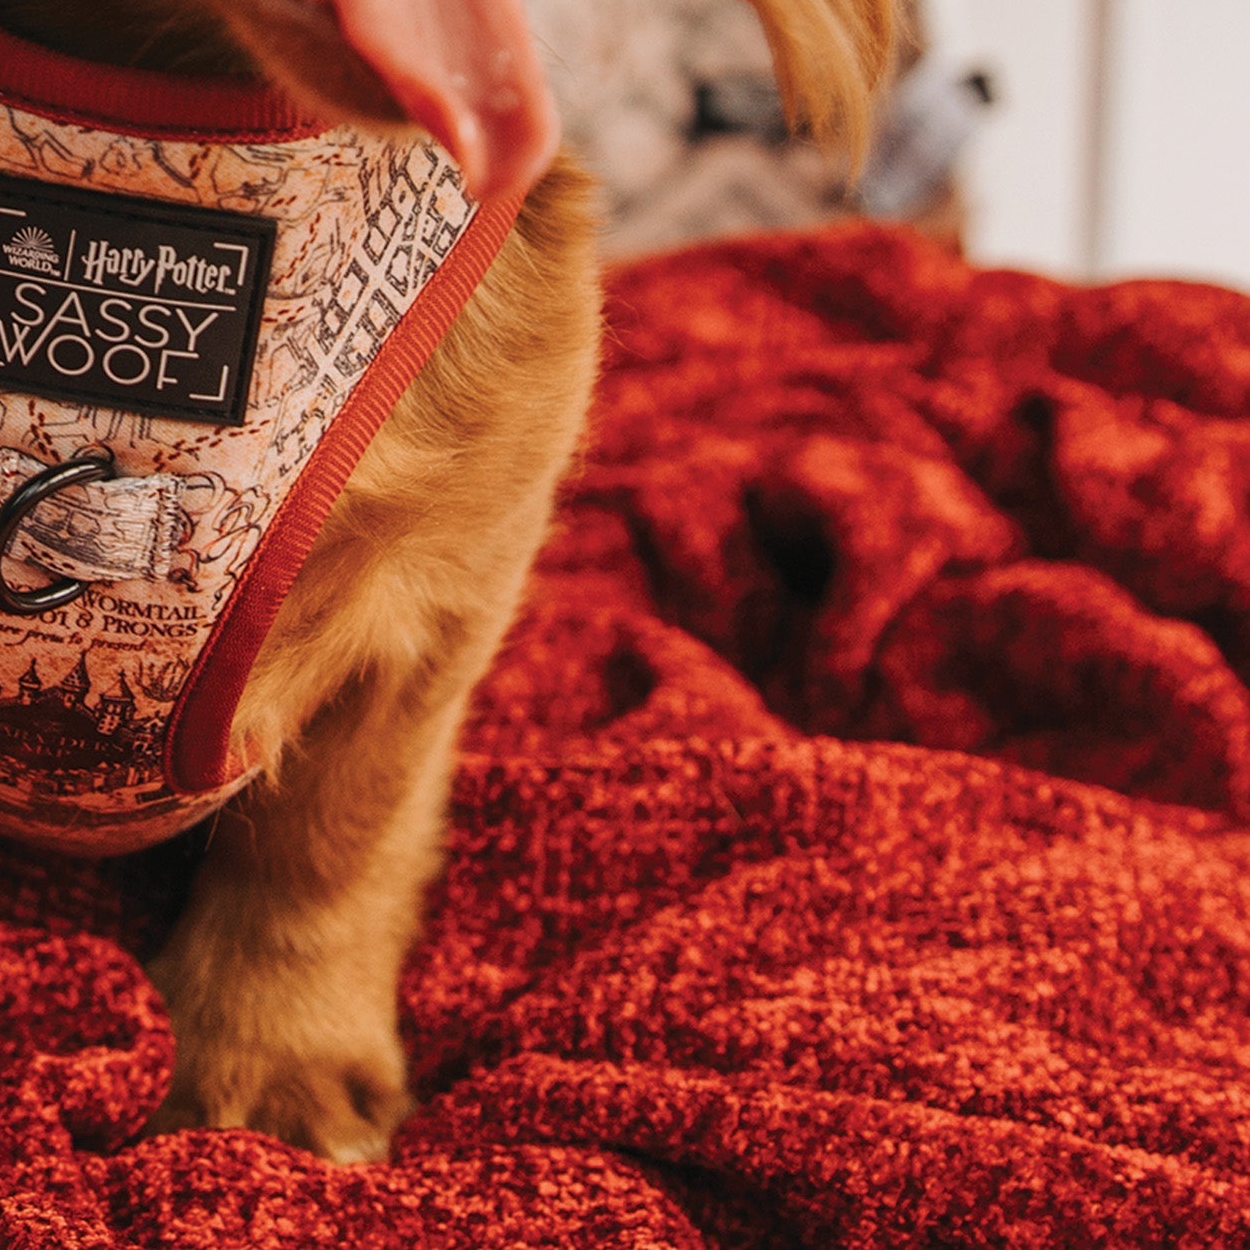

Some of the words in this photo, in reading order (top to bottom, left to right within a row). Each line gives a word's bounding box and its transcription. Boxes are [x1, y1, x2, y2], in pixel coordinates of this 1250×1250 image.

[8, 255, 53, 272] WORLD
[81, 240, 156, 287] Harry
[154, 245, 232, 295] Potter
[11, 282, 219, 352] SASSY
[101, 614, 199, 638] PRONGS
